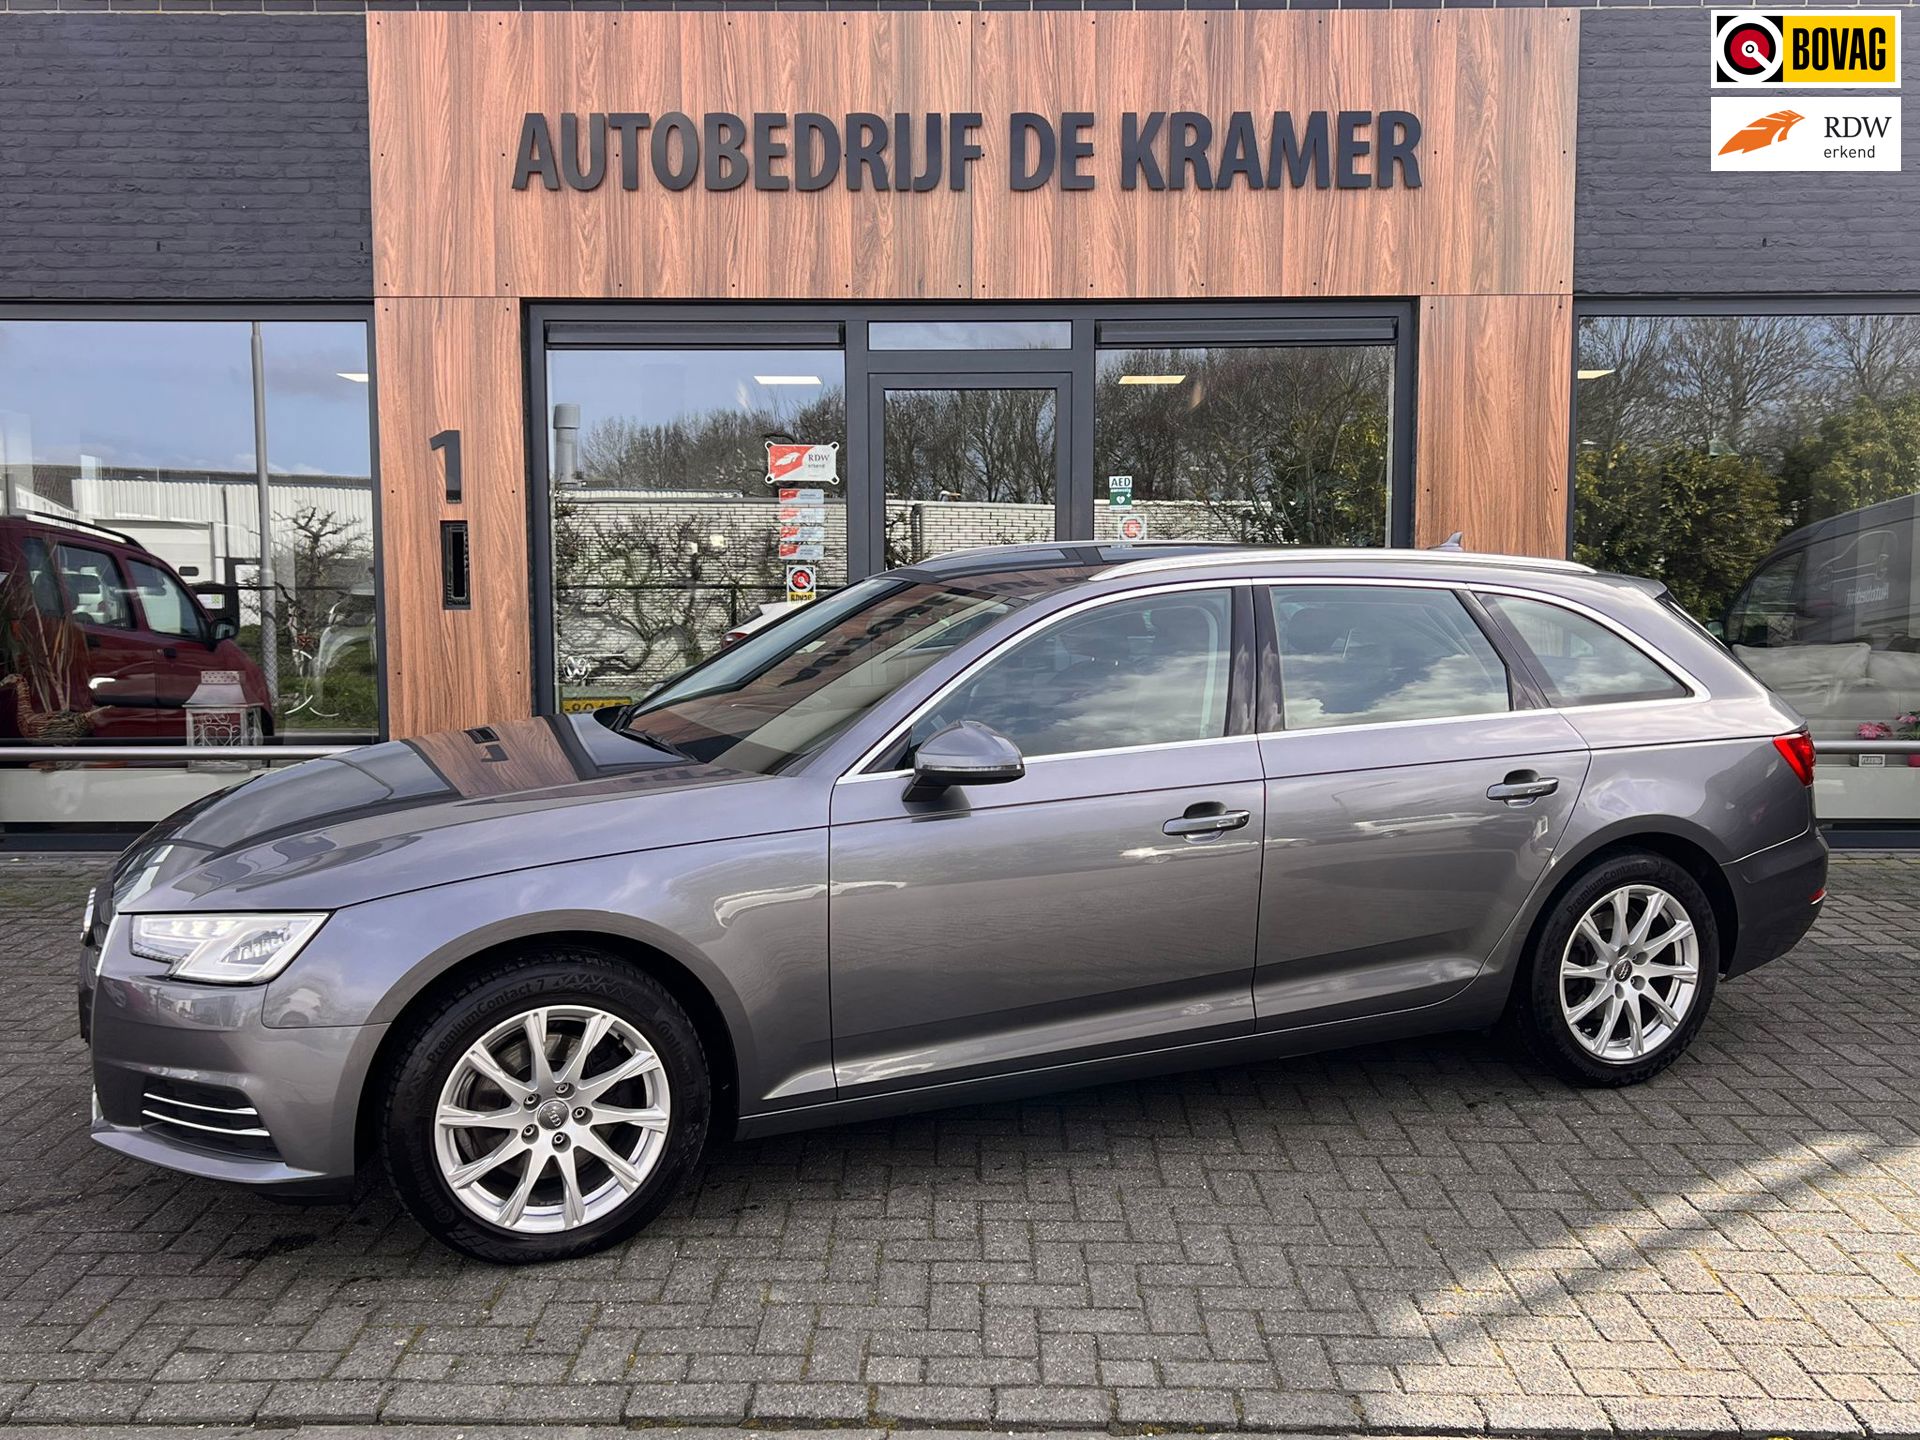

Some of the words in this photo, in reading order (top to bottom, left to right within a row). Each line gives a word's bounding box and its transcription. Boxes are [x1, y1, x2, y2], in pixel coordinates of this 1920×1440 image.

[512, 111, 982, 192] AUTOBEDRIJF
[1010, 112, 1095, 191] DE
[1121, 110, 1422, 190] KRAMER
[430, 430, 461, 503] 1
[808, 454, 830, 462] RDW
[1111, 477, 1131, 487] AED
